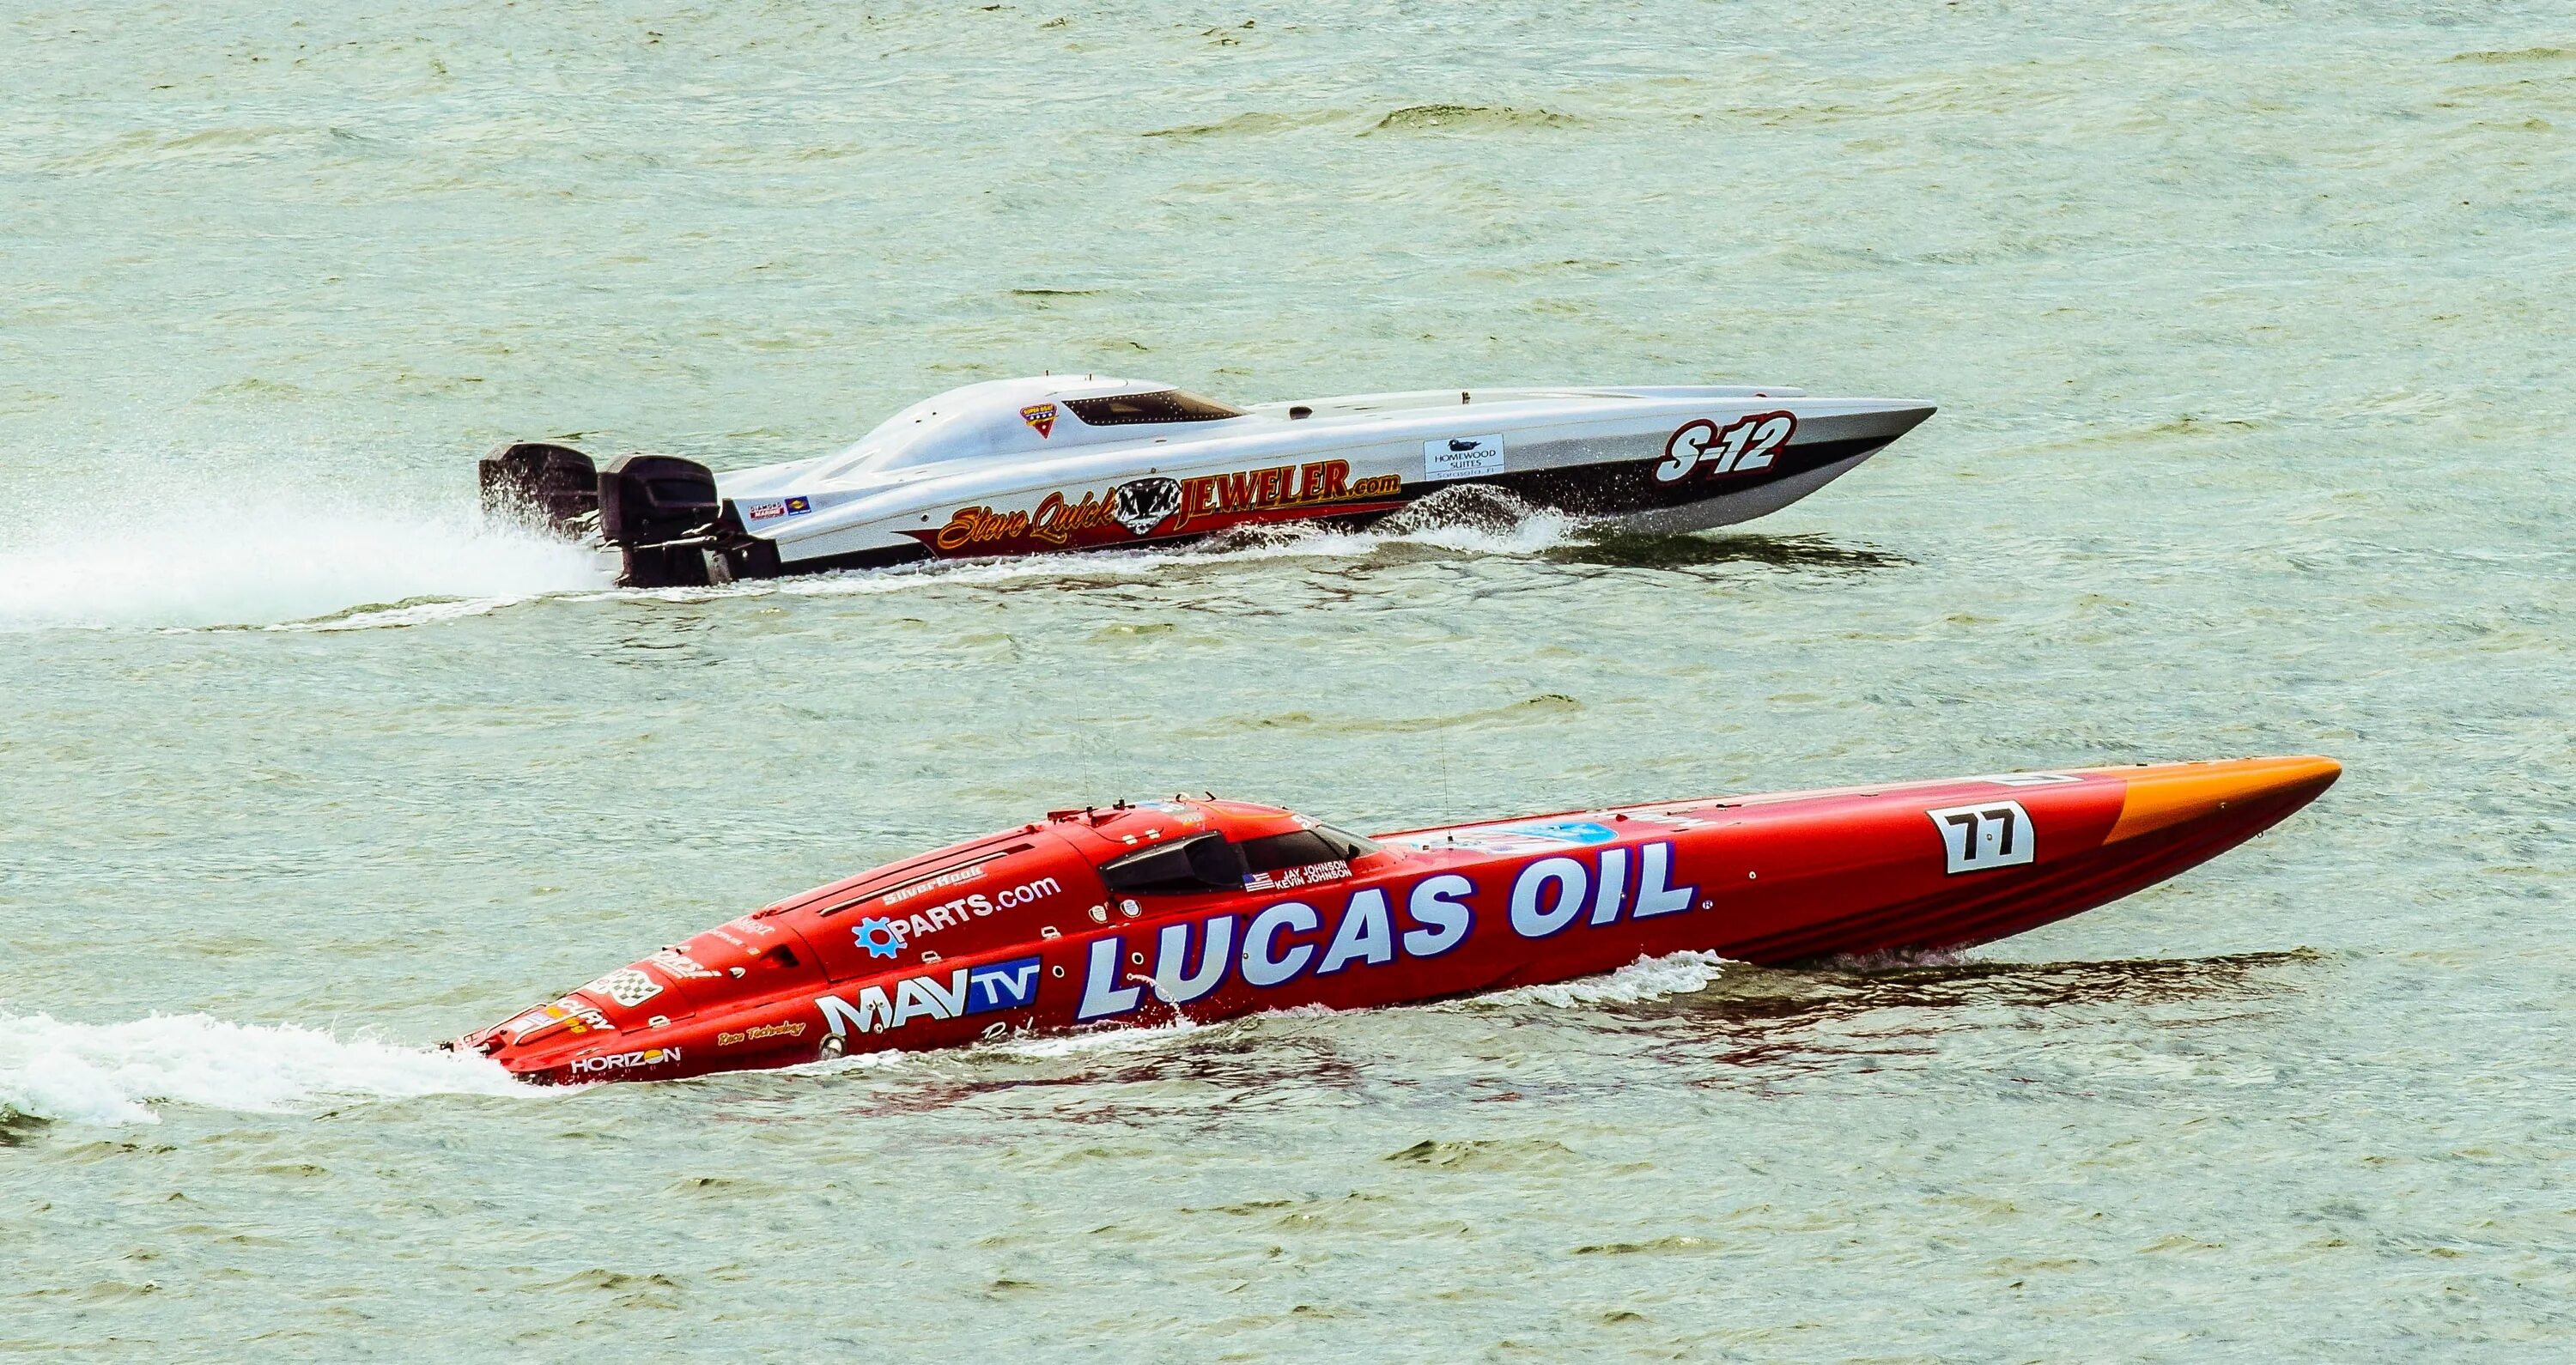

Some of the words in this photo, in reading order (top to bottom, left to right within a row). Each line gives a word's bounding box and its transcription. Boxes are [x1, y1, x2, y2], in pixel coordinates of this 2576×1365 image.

[1434, 449, 1497, 463] HOMEWOOD
[1652, 411, 1796, 485] S-12
[1449, 460, 1482, 469] SUITES
[938, 506, 1030, 549] Steve
[1030, 487, 1115, 544] Quick
[1944, 808, 2014, 861] 77
[1274, 877, 1305, 890] KEVIN
[1306, 868, 1352, 884] JOHNSON
[1283, 868, 1303, 881] JAY
[1303, 859, 1348, 876] JOHNSON
[1077, 874, 1471, 1020] LUCAS
[1510, 840, 1695, 937] OIL
[570, 1046, 682, 1074] HORIZON
